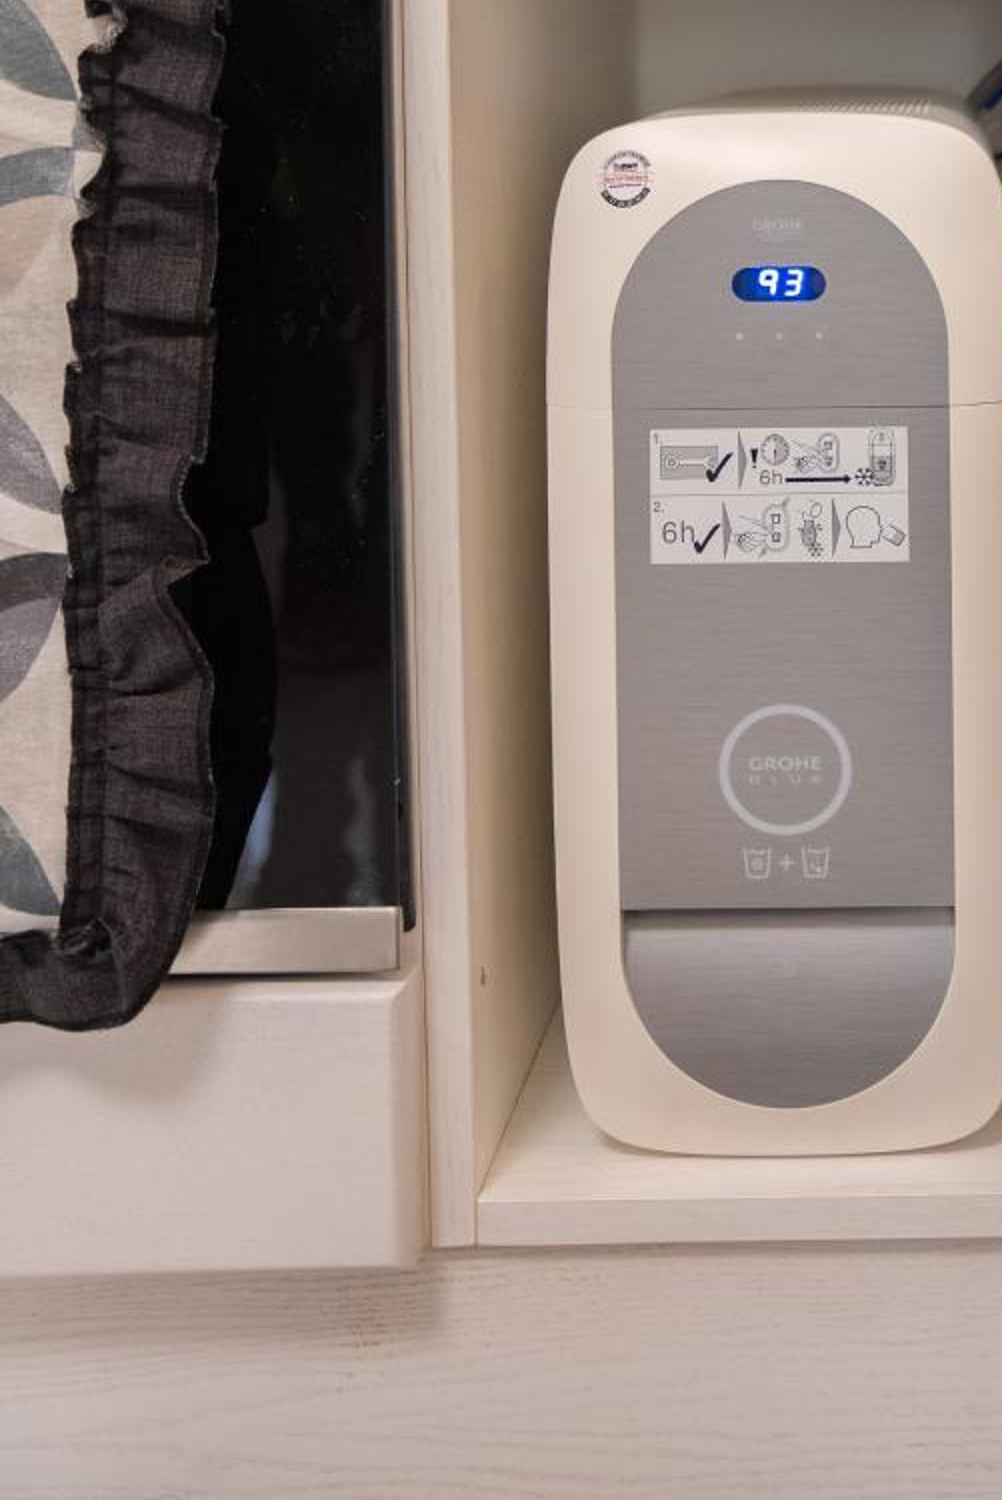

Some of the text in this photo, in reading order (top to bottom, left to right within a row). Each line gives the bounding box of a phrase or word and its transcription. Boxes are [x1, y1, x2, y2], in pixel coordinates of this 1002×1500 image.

[758, 268, 804, 297] 93
[759, 470, 783, 485] 6h
[662, 520, 695, 544] 6h
[749, 755, 823, 772] GROHE
